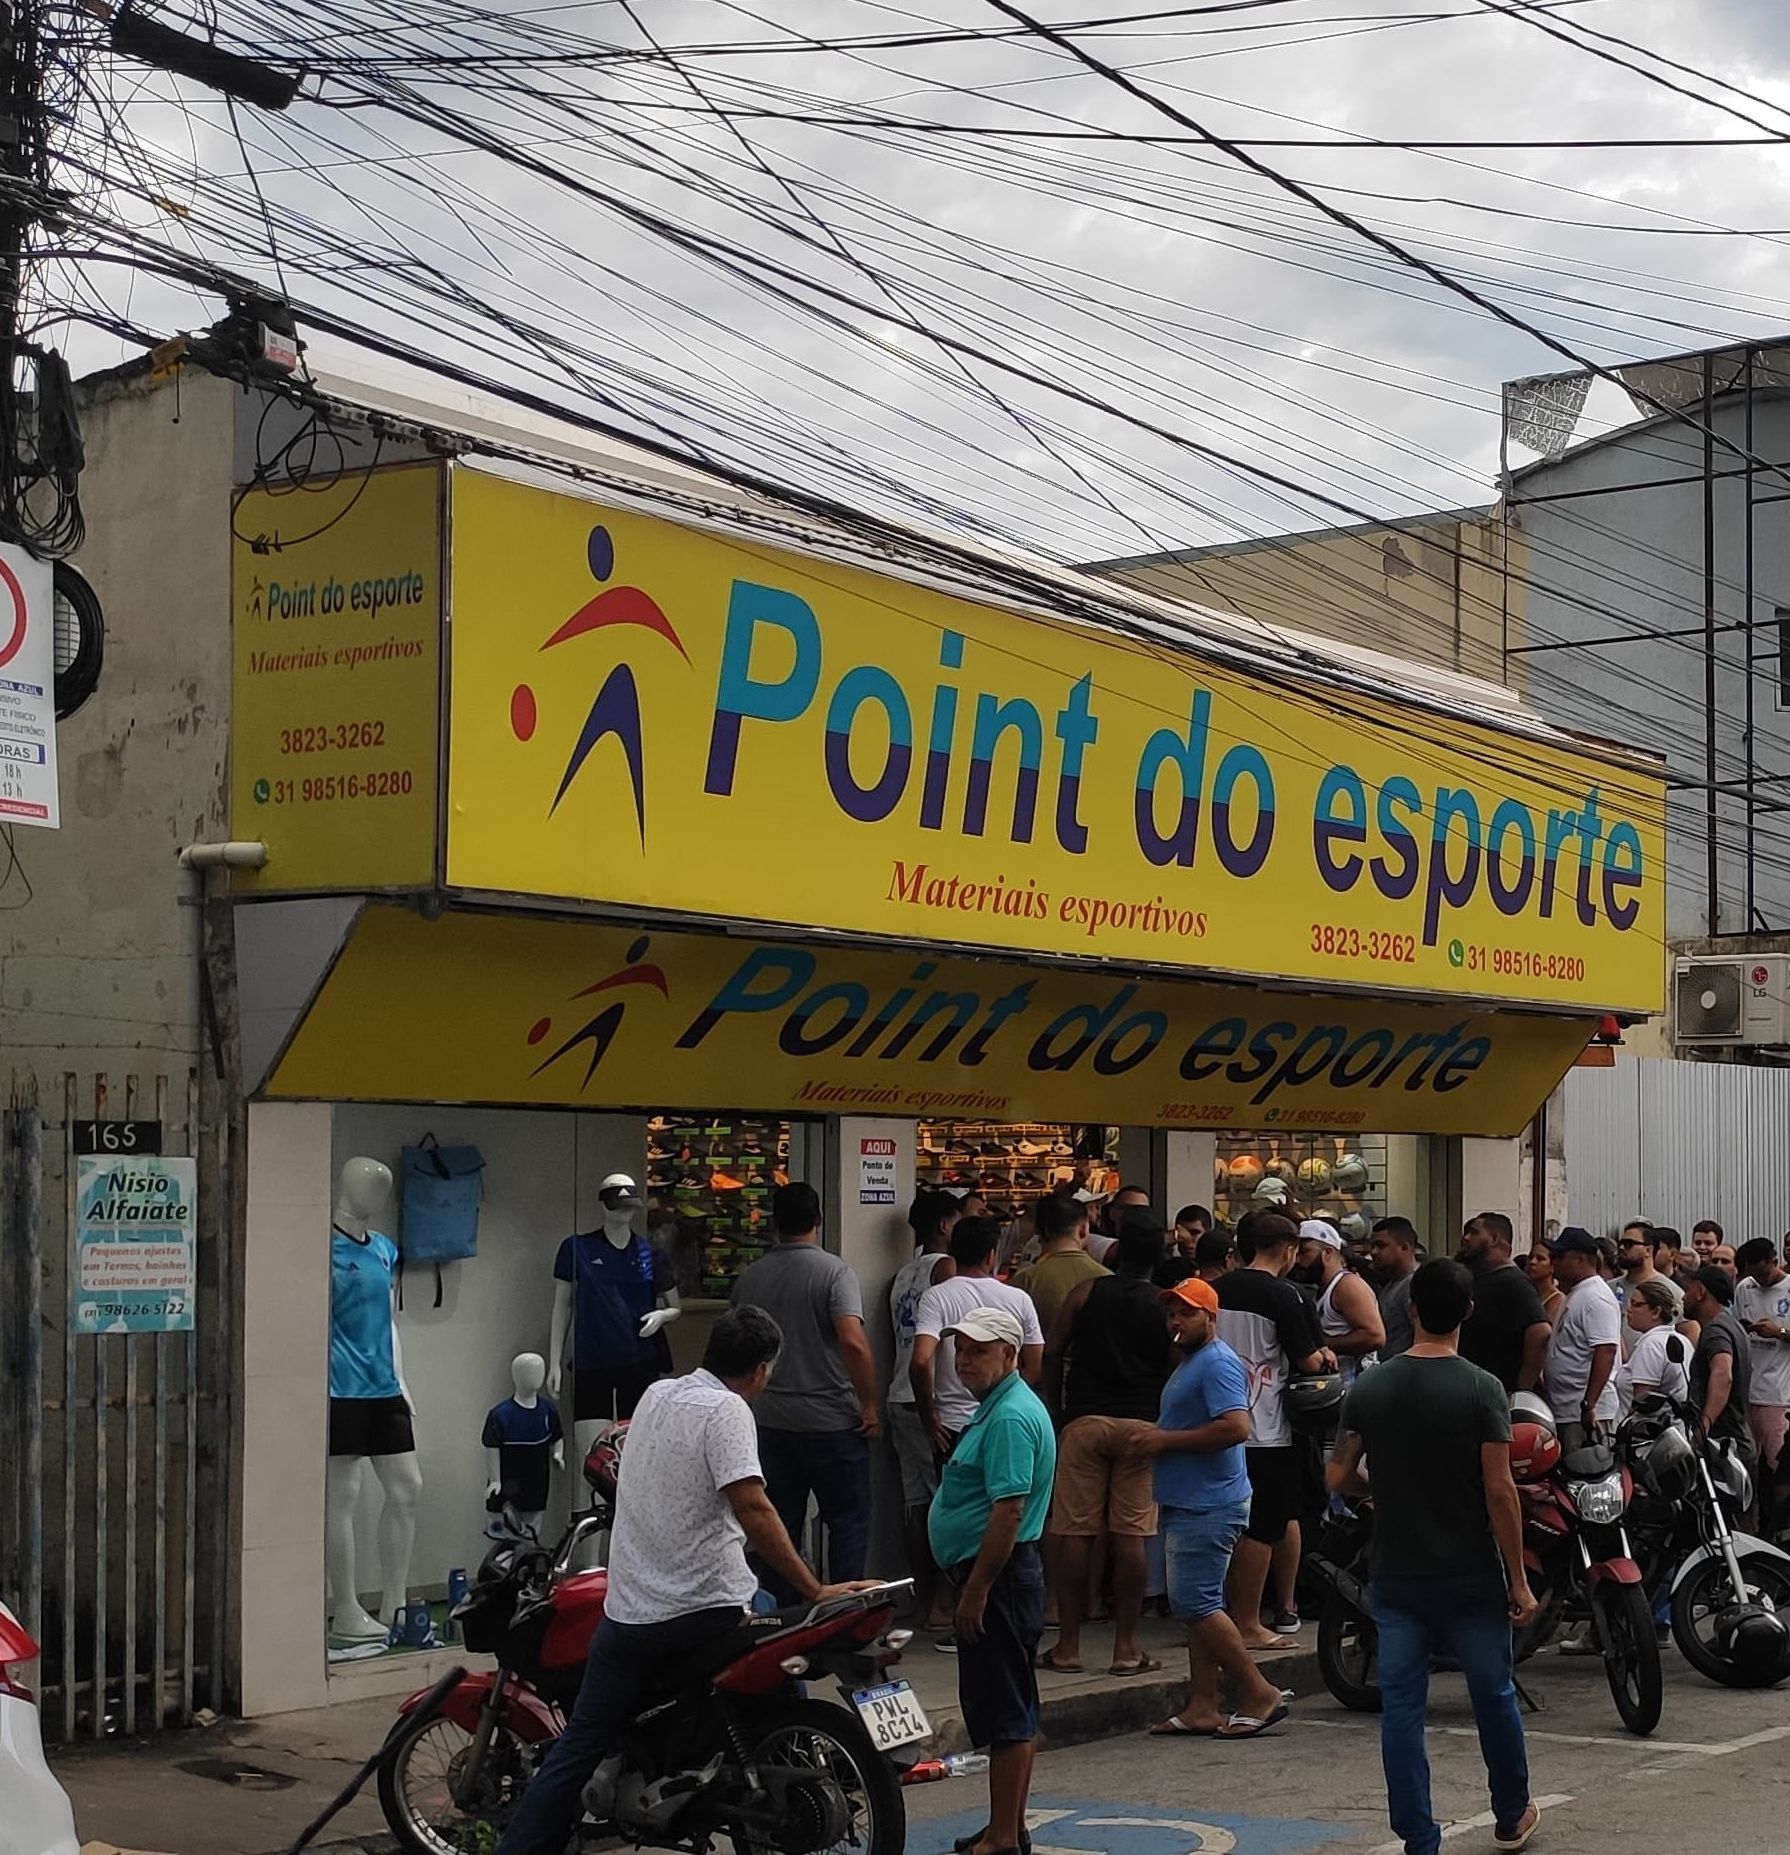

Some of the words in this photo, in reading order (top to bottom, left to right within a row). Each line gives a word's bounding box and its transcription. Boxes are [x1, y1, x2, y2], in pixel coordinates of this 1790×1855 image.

[267, 580, 316, 621] Point
[321, 575, 344, 615] do
[350, 569, 423, 619] esporte
[247, 645, 328, 675] Materiais
[334, 636, 423, 670] esportivos
[18, 683, 39, 695] AZUL
[280, 721, 385, 754] 3823-3262
[4, 763, 14, 778] 18
[16, 764, 22, 779] h
[703, 579, 1099, 855] Point
[1134, 687, 1276, 879] do
[1313, 764, 1643, 947] esporte
[2, 782, 12, 796] 13
[16, 783, 22, 798] h
[274, 780, 294, 804] 31
[302, 770, 412, 802] 98516-8280
[885, 860, 1050, 920] Materiais
[1058, 896, 1208, 939] esportivos
[1310, 924, 1415, 963] 3823-3262
[1467, 945, 1487, 972] 31
[1492, 948, 1585, 981] 98516-8280
[1753, 988, 1767, 998] LG
[674, 946, 1044, 1066] Point
[1026, 983, 1169, 1076] do
[1179, 1017, 1492, 1105] esporte
[792, 1080, 903, 1104] Materiais
[904, 1088, 1011, 1110] esportivos
[1157, 1103, 1234, 1120] 3823-3262
[1276, 1109, 1295, 1123] 31
[88, 1123, 136, 1151] 165
[866, 1141, 891, 1154] AQUI
[86, 1199, 188, 1221] Alfaiate
[92, 1277, 140, 1286] costuras
[160, 1275, 187, 1288] geral
[871, 1695, 910, 1722] PWL
[876, 1713, 925, 1743] 8C14
